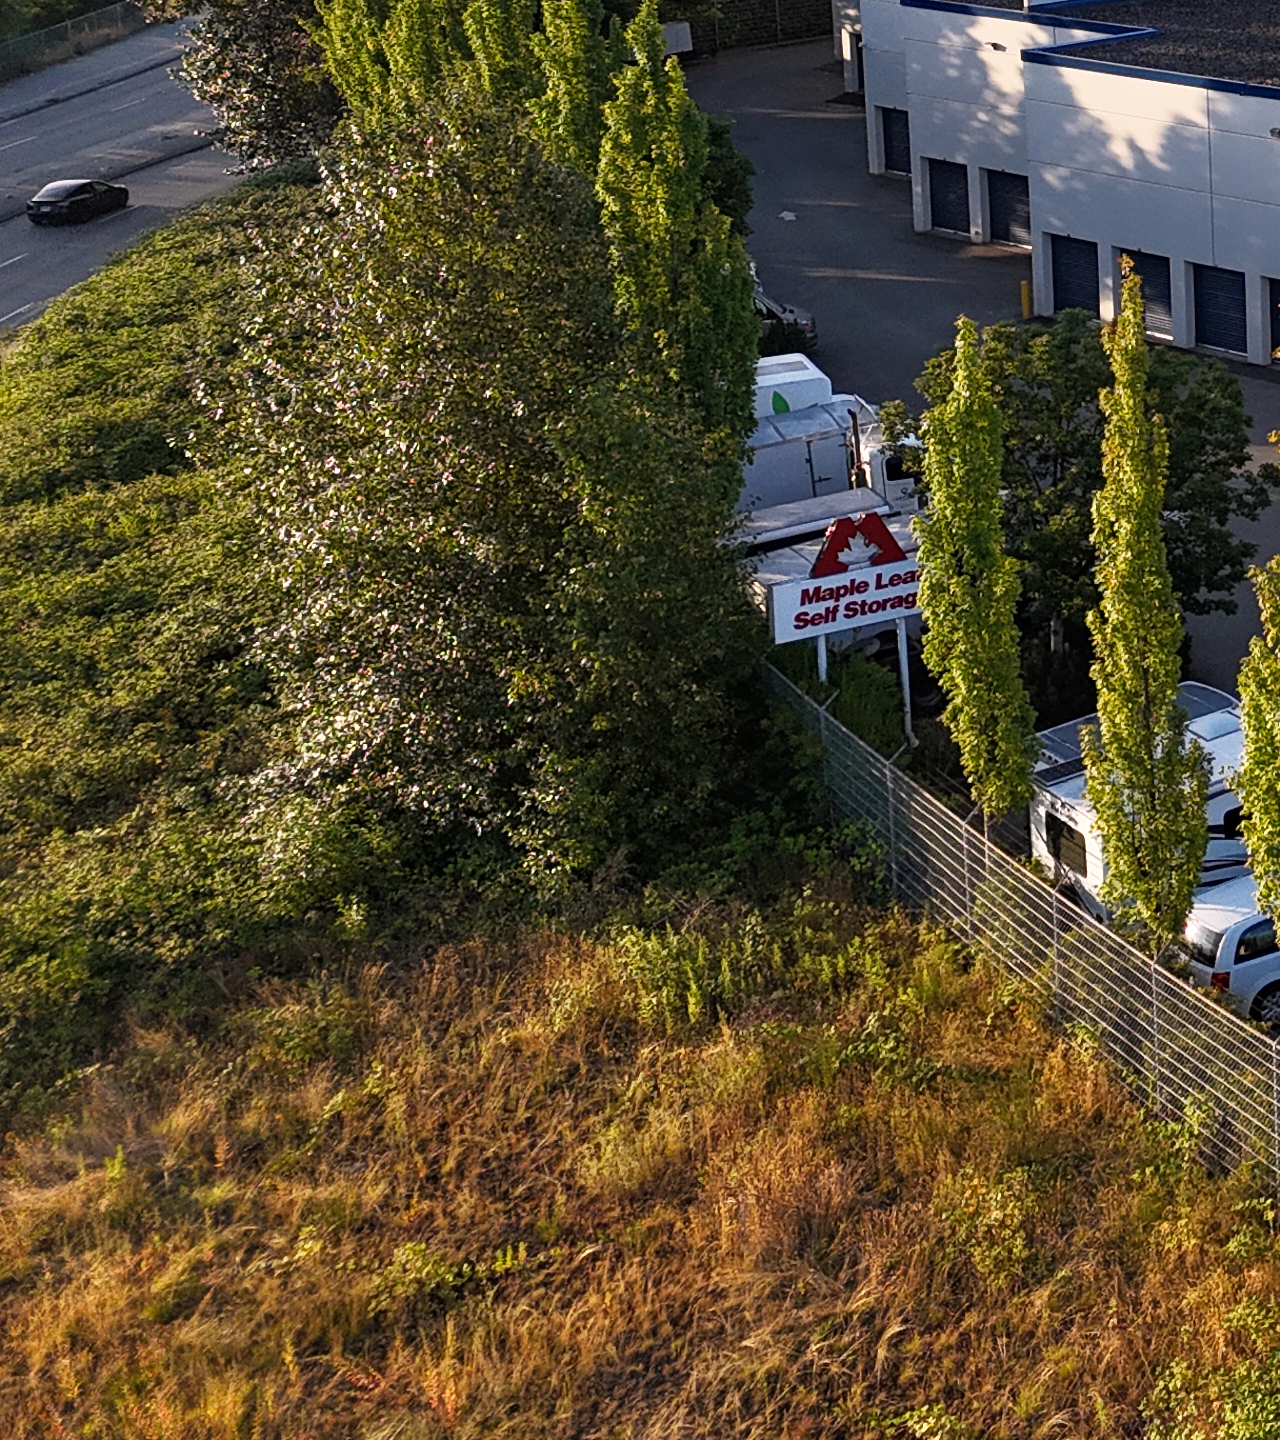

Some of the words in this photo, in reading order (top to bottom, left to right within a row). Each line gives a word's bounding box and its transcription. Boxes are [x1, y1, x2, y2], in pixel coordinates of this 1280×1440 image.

[800, 578, 869, 607] Maple
[875, 569, 920, 591] Lea
[793, 604, 840, 630] Self
[843, 591, 919, 620] Storag
